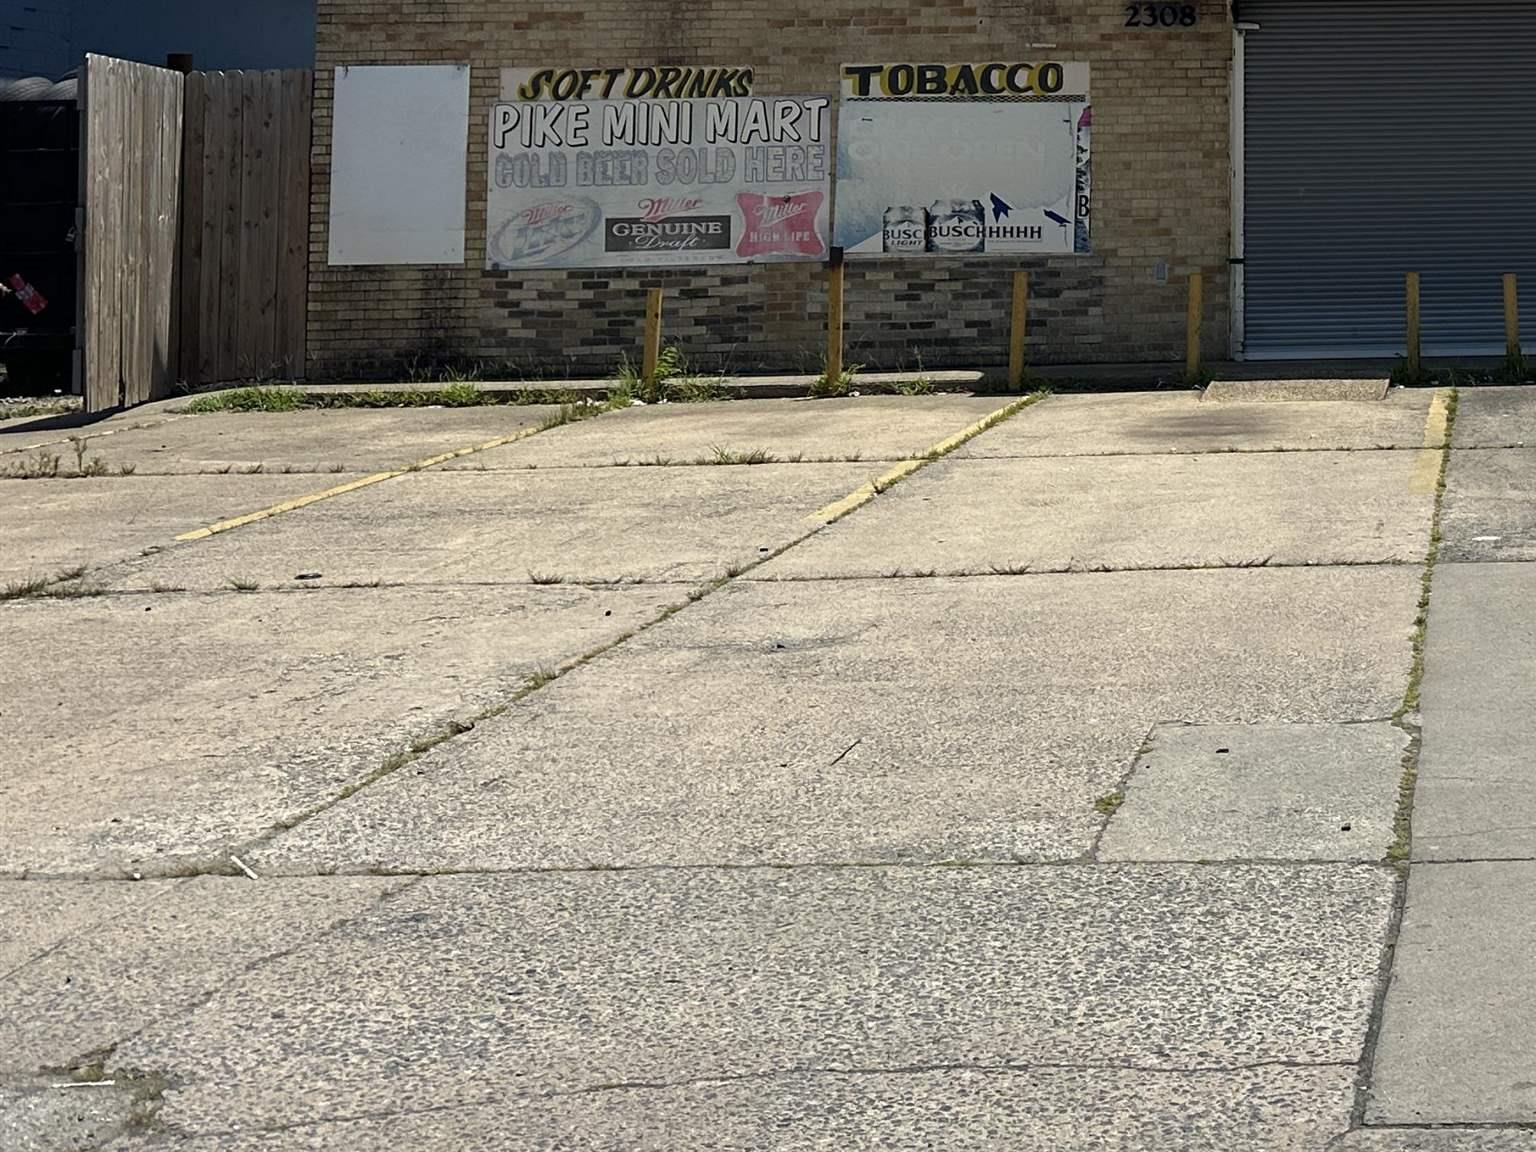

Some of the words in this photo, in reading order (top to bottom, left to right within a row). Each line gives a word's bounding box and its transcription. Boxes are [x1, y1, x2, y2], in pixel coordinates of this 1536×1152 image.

[1124, 5, 1197, 27] 2308
[519, 67, 627, 100] SOFT
[620, 66, 753, 99] DRINKS
[845, 63, 1064, 96] TOBACCO
[492, 102, 591, 148] PIKE
[602, 100, 693, 147] MINI
[706, 98, 830, 145] MART
[494, 151, 567, 188] COLD
[575, 150, 650, 187] BEER
[655, 147, 737, 185] SOLD
[744, 145, 826, 183] HERE
[612, 221, 723, 236] GENUINE
[634, 233, 699, 251] Draft
